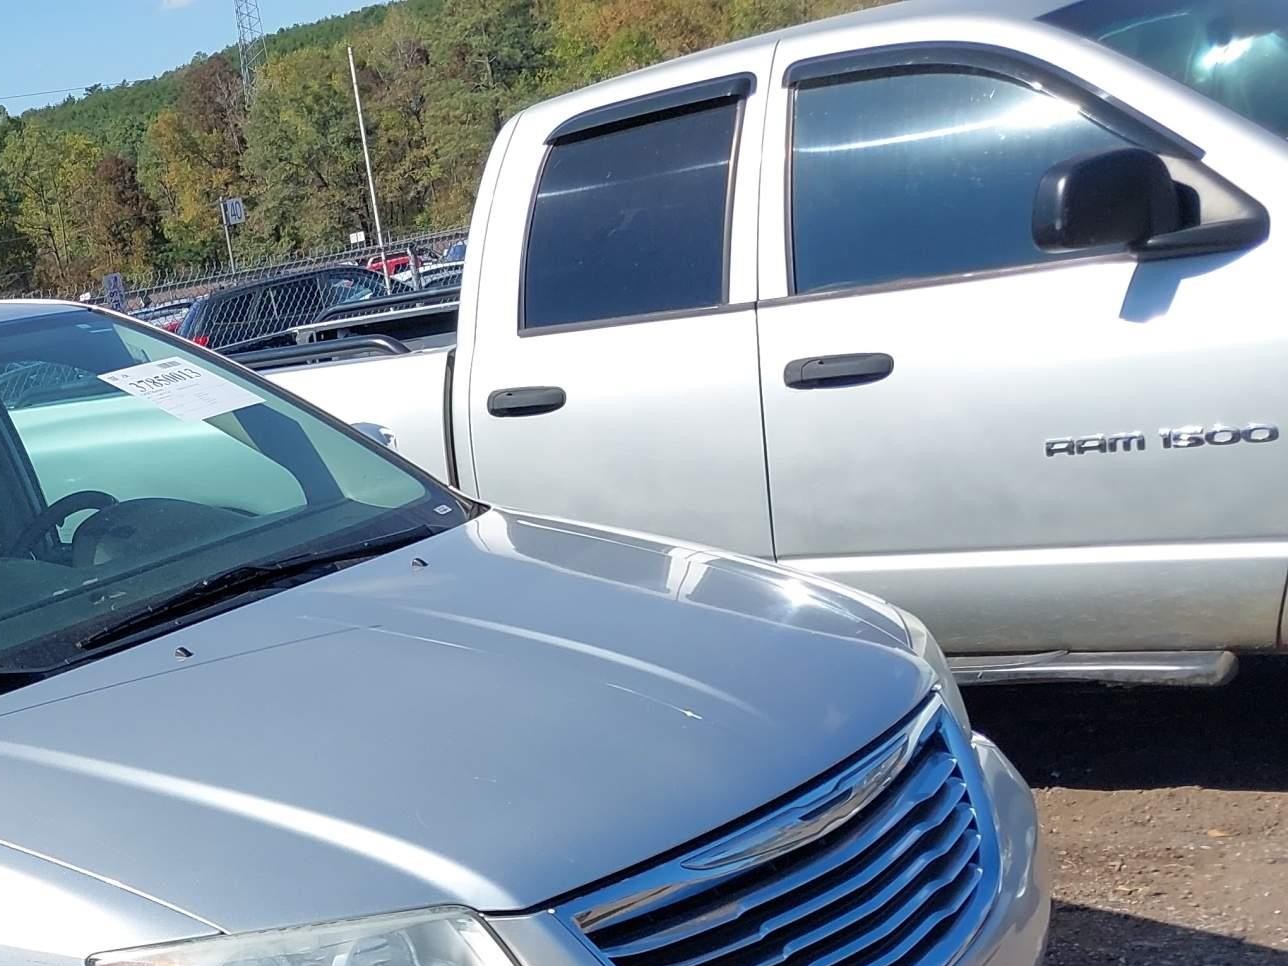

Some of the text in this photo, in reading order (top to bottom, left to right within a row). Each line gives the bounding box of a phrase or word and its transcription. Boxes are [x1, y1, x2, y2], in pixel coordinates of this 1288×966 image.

[229, 201, 243, 222] 40
[129, 368, 202, 393] 37850013
[1045, 421, 1280, 457] RAM 1500
